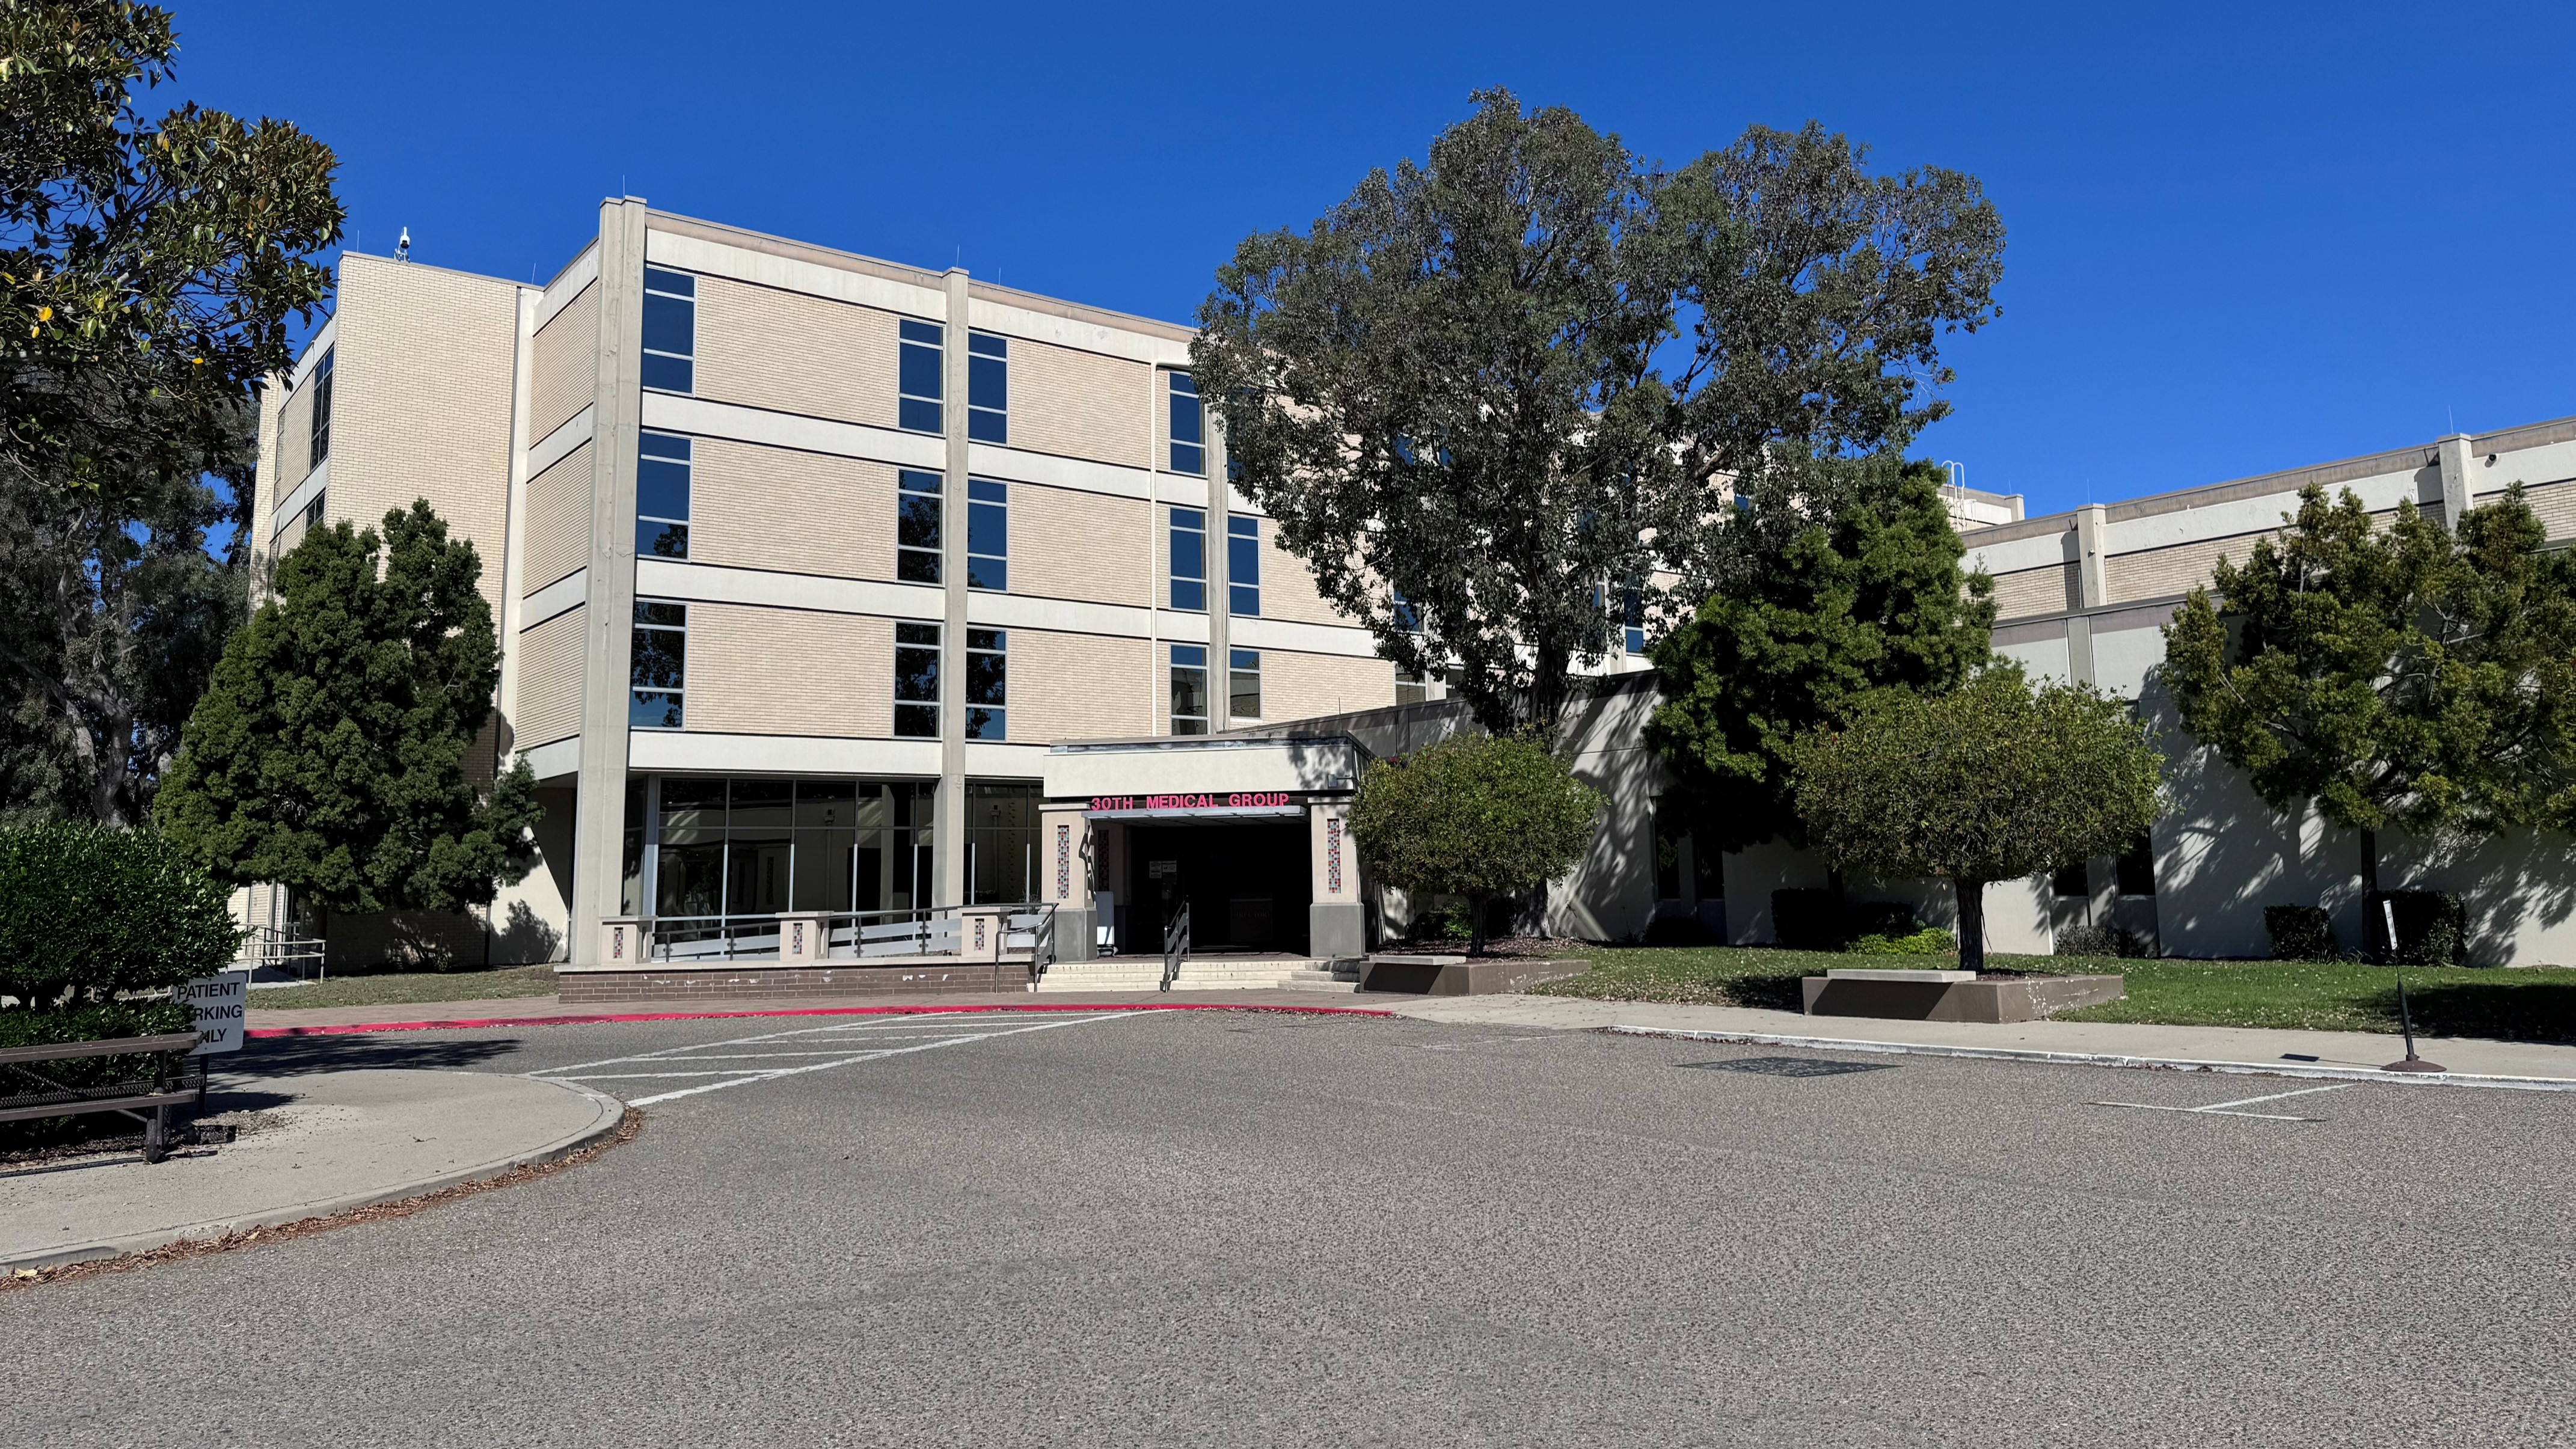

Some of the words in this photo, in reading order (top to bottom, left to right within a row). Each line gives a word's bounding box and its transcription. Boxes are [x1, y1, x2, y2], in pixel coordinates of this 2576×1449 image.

[1091, 797, 1133, 810] 30TH
[1146, 794, 1218, 809] MEDICAL
[1228, 793, 1289, 807] GROUP
[177, 982, 240, 999] PATIENT
[194, 1004, 242, 1021] RKING
[200, 1028, 227, 1043] NLY
